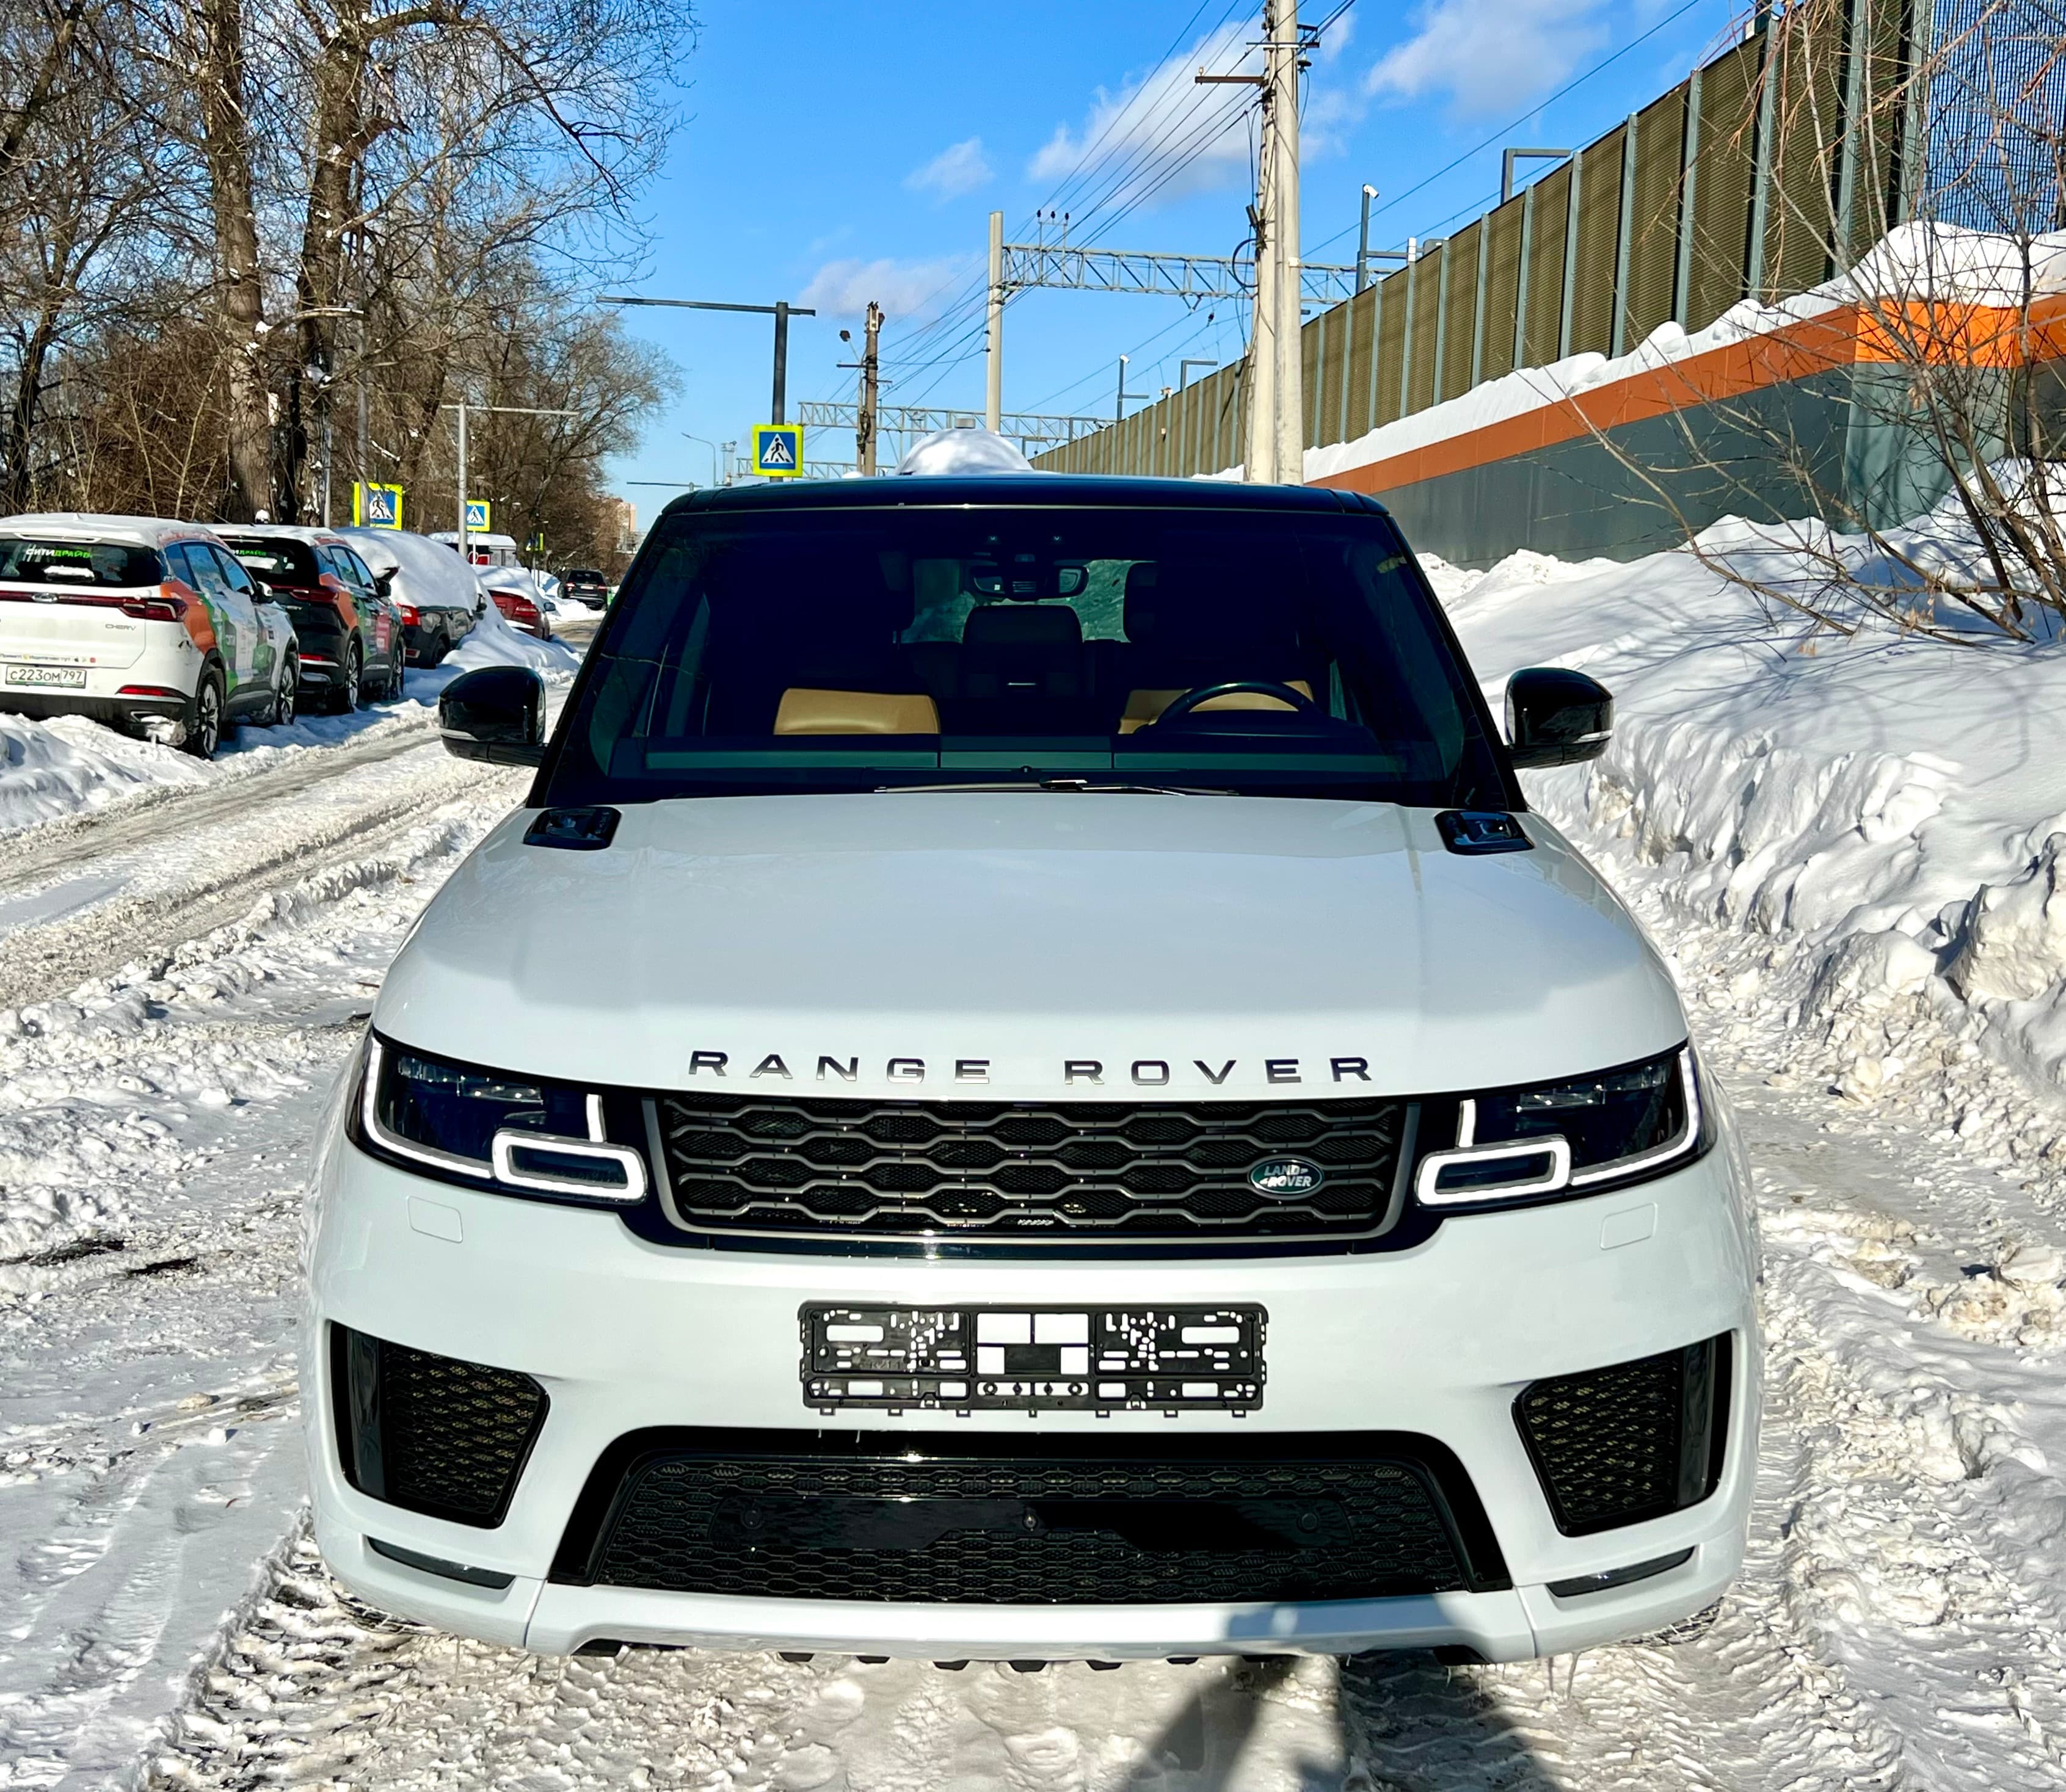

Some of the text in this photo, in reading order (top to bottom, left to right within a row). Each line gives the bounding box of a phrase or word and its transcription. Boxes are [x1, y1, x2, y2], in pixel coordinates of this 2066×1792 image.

[63, 670, 82, 681] 797
[688, 1050, 1373, 1086] RANGE ROVER
[1264, 1164, 1300, 1176] LAND
[1267, 1175, 1312, 1188] ROVER
